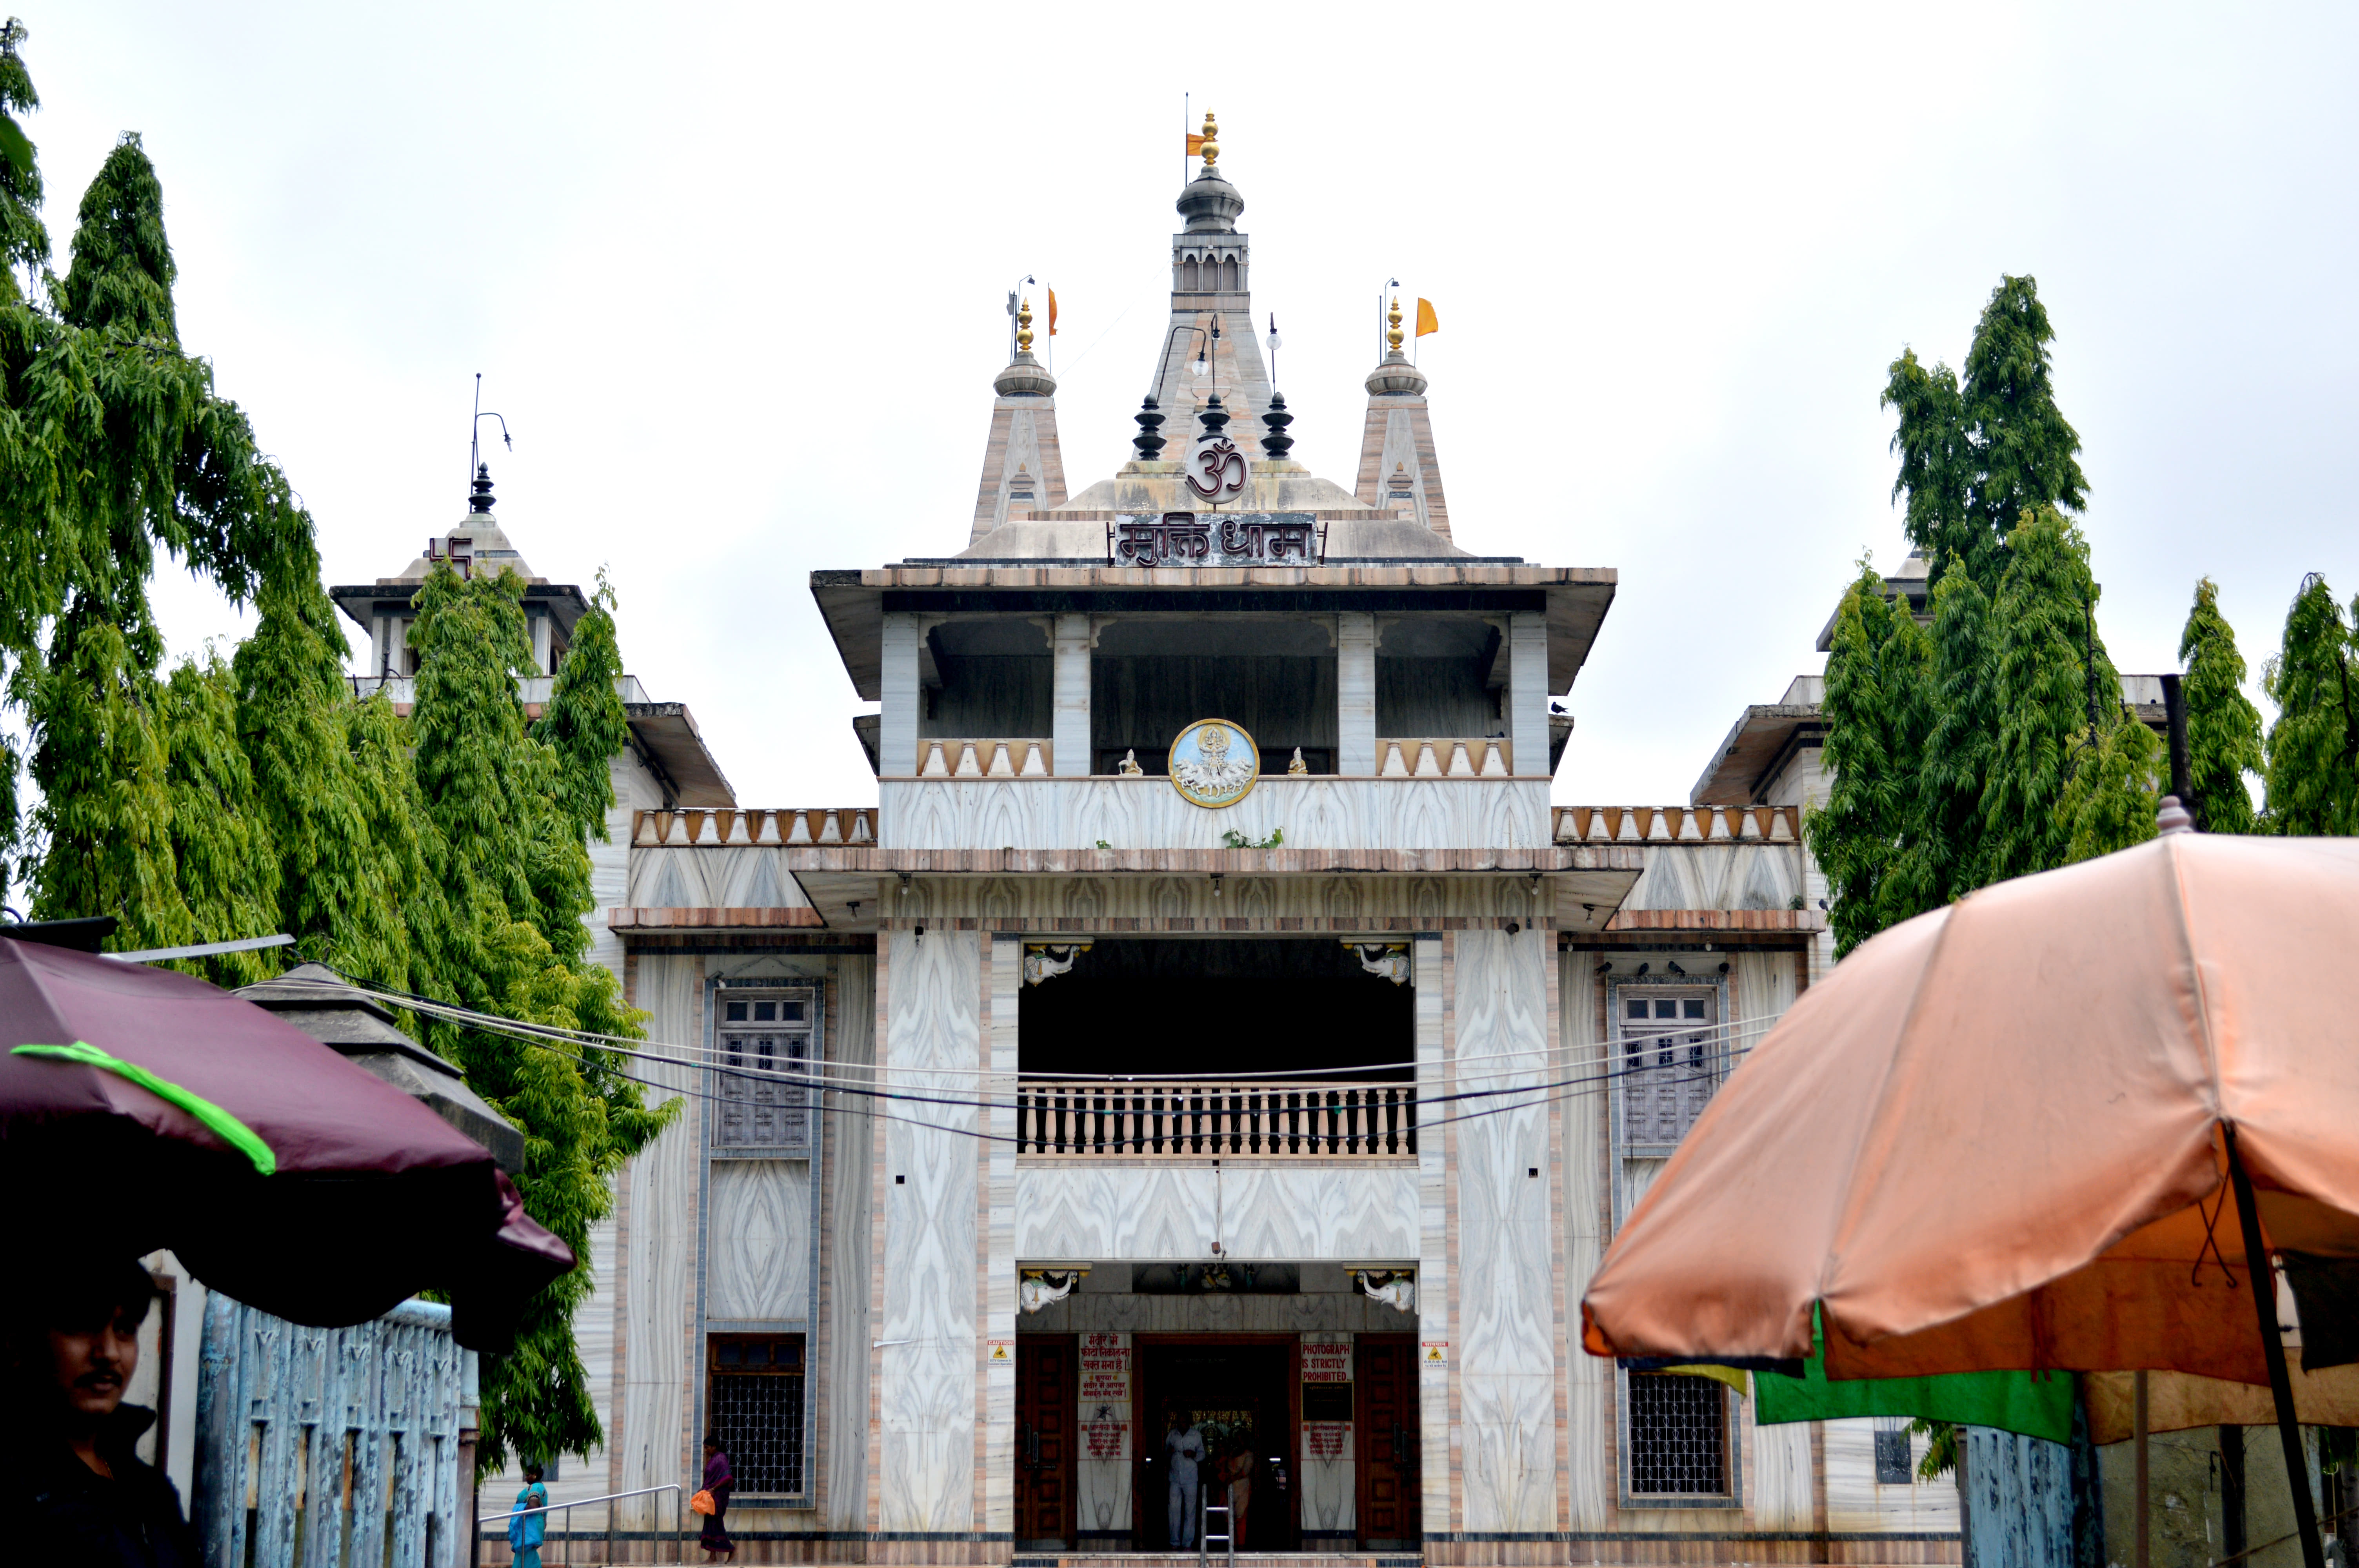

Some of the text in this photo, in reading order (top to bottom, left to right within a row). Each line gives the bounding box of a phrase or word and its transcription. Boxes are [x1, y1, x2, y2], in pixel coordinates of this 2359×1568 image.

[1120, 512, 1312, 567] मुक्ति धाम
[1081, 1346, 1098, 1357] फोटो
[1303, 1344, 1349, 1354] PHOTOGRAPH
[1101, 1361, 1114, 1370] मना
[1302, 1359, 1346, 1368] IS STRICTLY
[1303, 1372, 1349, 1381] PROHIBITED.
